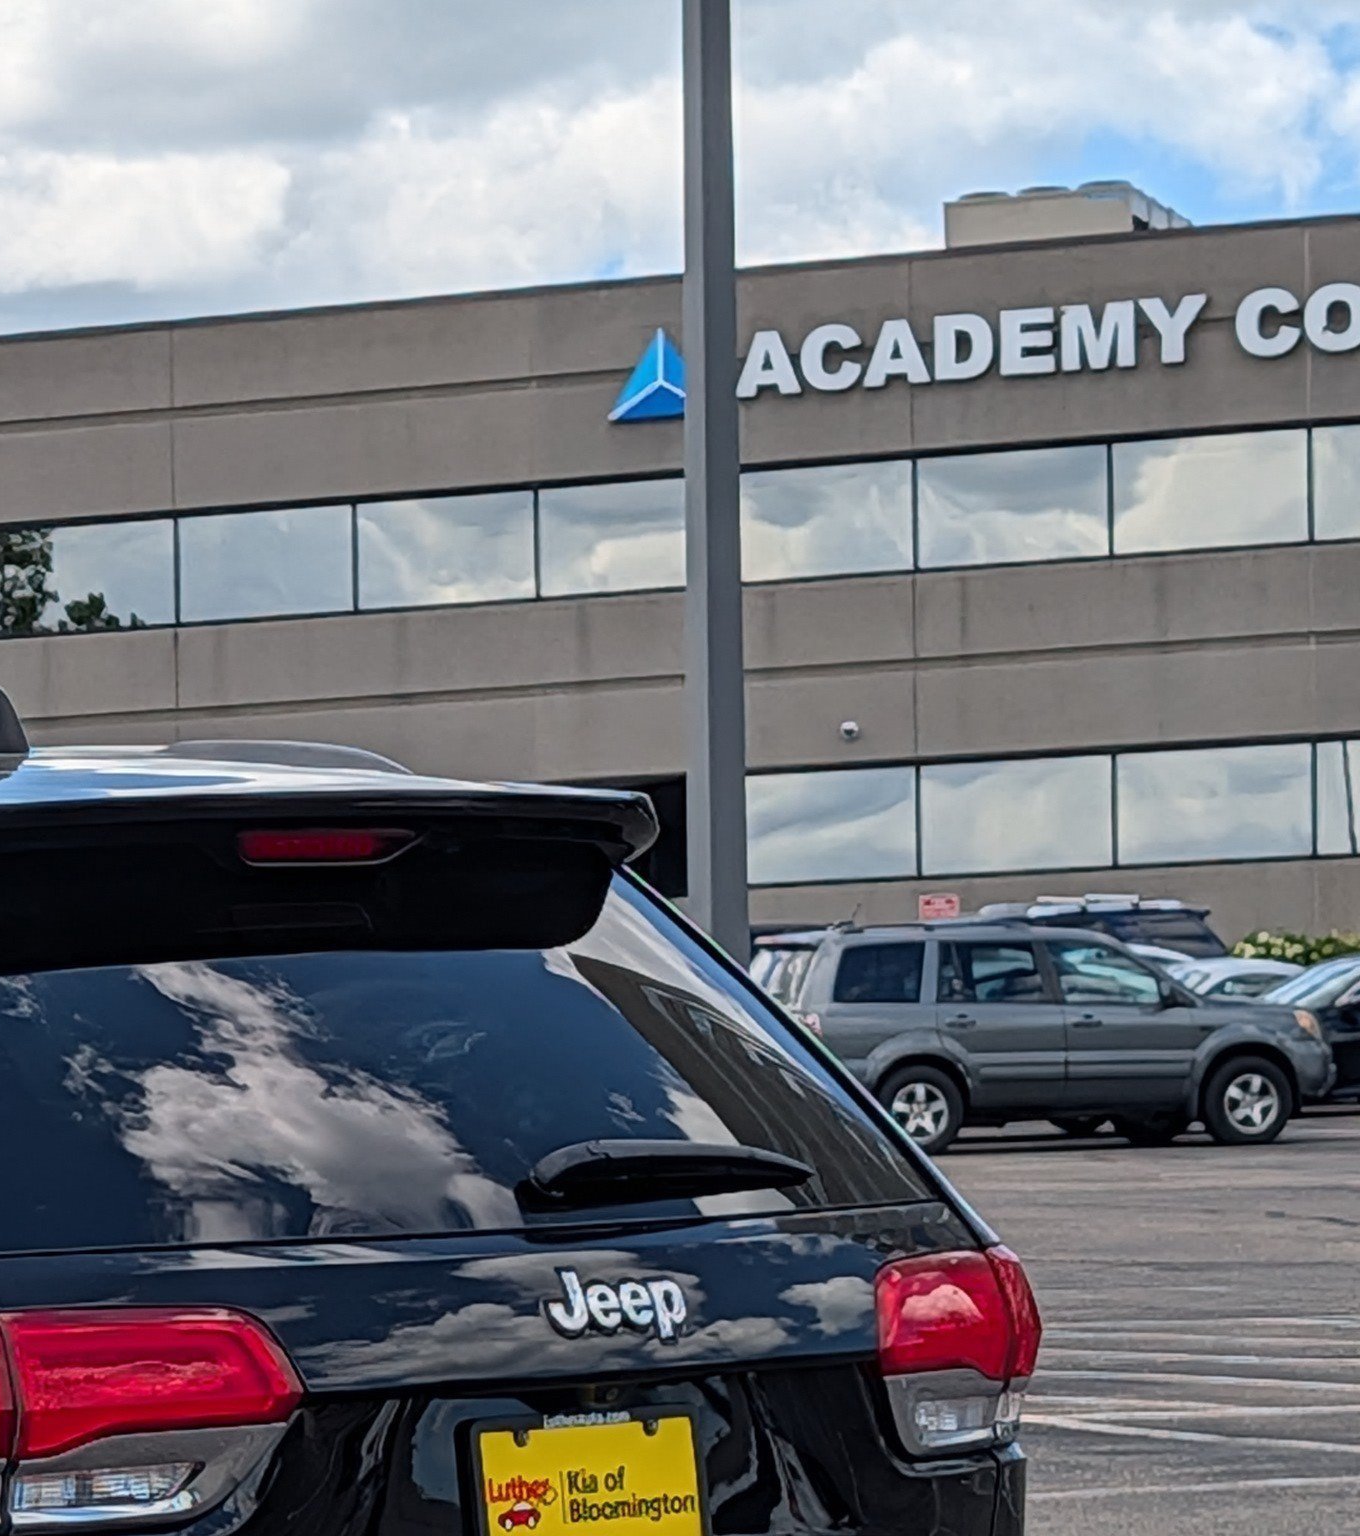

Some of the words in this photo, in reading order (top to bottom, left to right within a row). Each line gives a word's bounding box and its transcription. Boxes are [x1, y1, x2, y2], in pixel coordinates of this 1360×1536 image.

[735, 293, 1208, 400] ACADEMY
[1235, 282, 1360, 358] CO
[545, 1266, 688, 1343] Jeep
[488, 1475, 551, 1503] Luther
[567, 1468, 599, 1495] Kia
[604, 1465, 626, 1492] of
[569, 1493, 696, 1523] Bloomington
